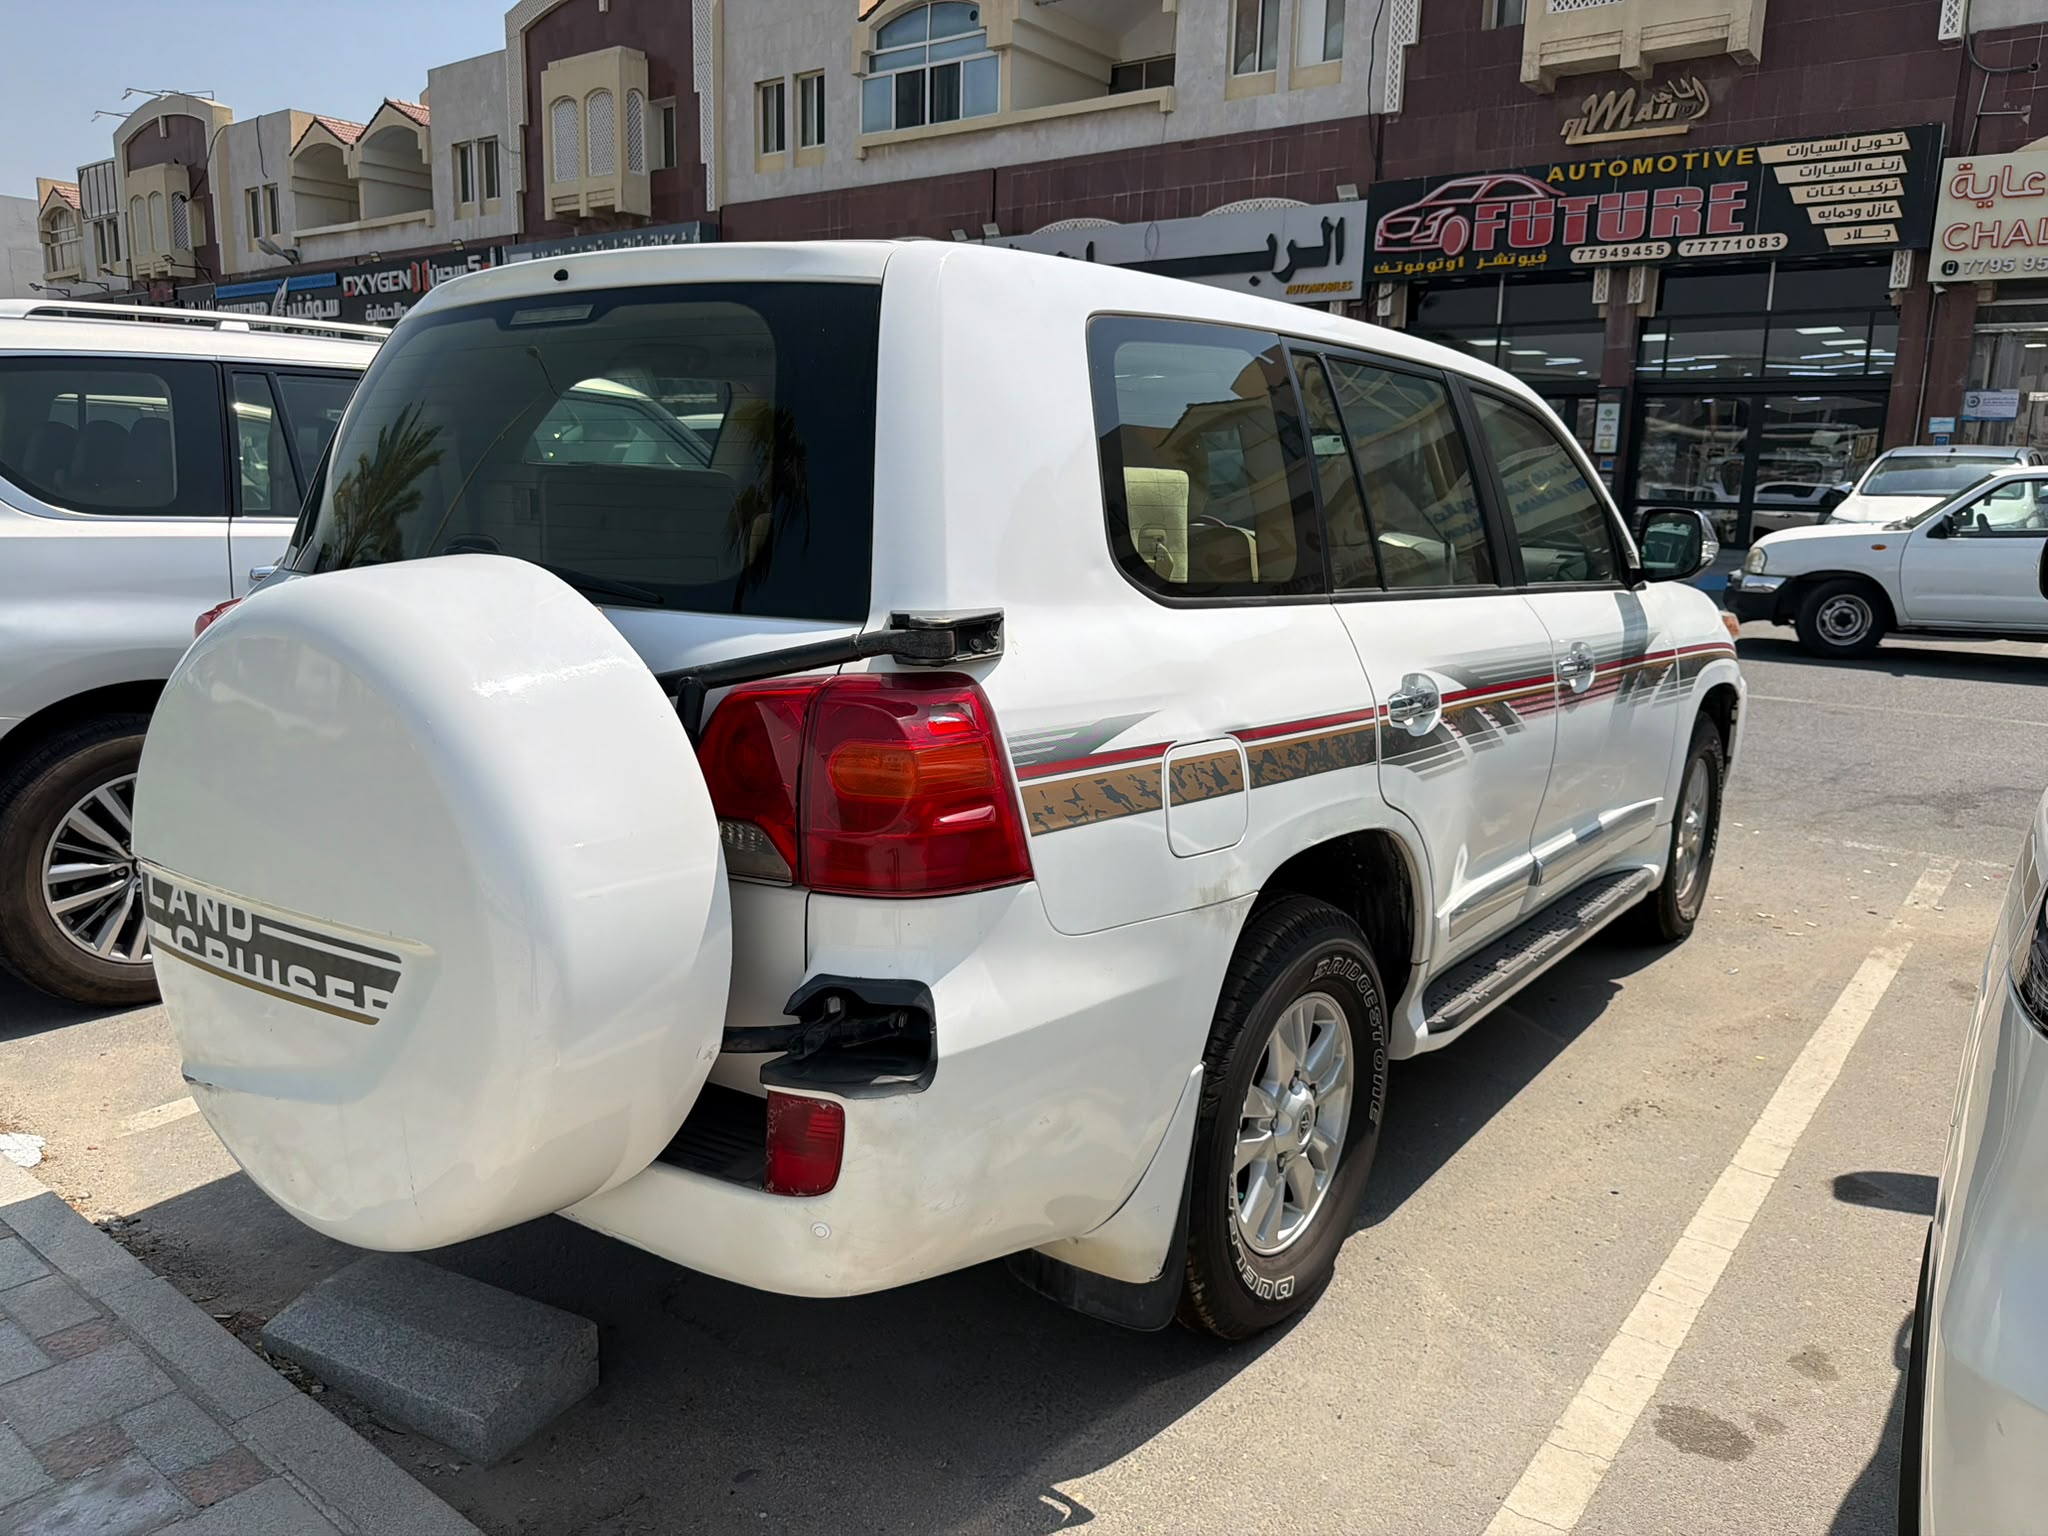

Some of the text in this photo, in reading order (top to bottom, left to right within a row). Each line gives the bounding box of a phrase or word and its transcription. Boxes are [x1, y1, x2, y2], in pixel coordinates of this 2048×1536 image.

[1786, 133, 1904, 158] تحويل السيارات
[1546, 147, 1756, 183] AUTOMOTIVE
[1799, 157, 1902, 178] زينه السيارات
[1805, 180, 1899, 199] تركيب كتات
[1472, 181, 1749, 252] FUTURE
[1817, 202, 1896, 221] عازل وحمايه
[1942, 217, 2048, 252] CHAL
[1475, 249, 1549, 270] فيوتشر
[1577, 235, 1782, 261] 77949455 77771083
[1963, 257, 2017, 276] 7795
[343, 268, 411, 297] OXYGEN
[148, 871, 253, 943] LAND
[1310, 956, 1386, 1126] BRIDGESTONE
